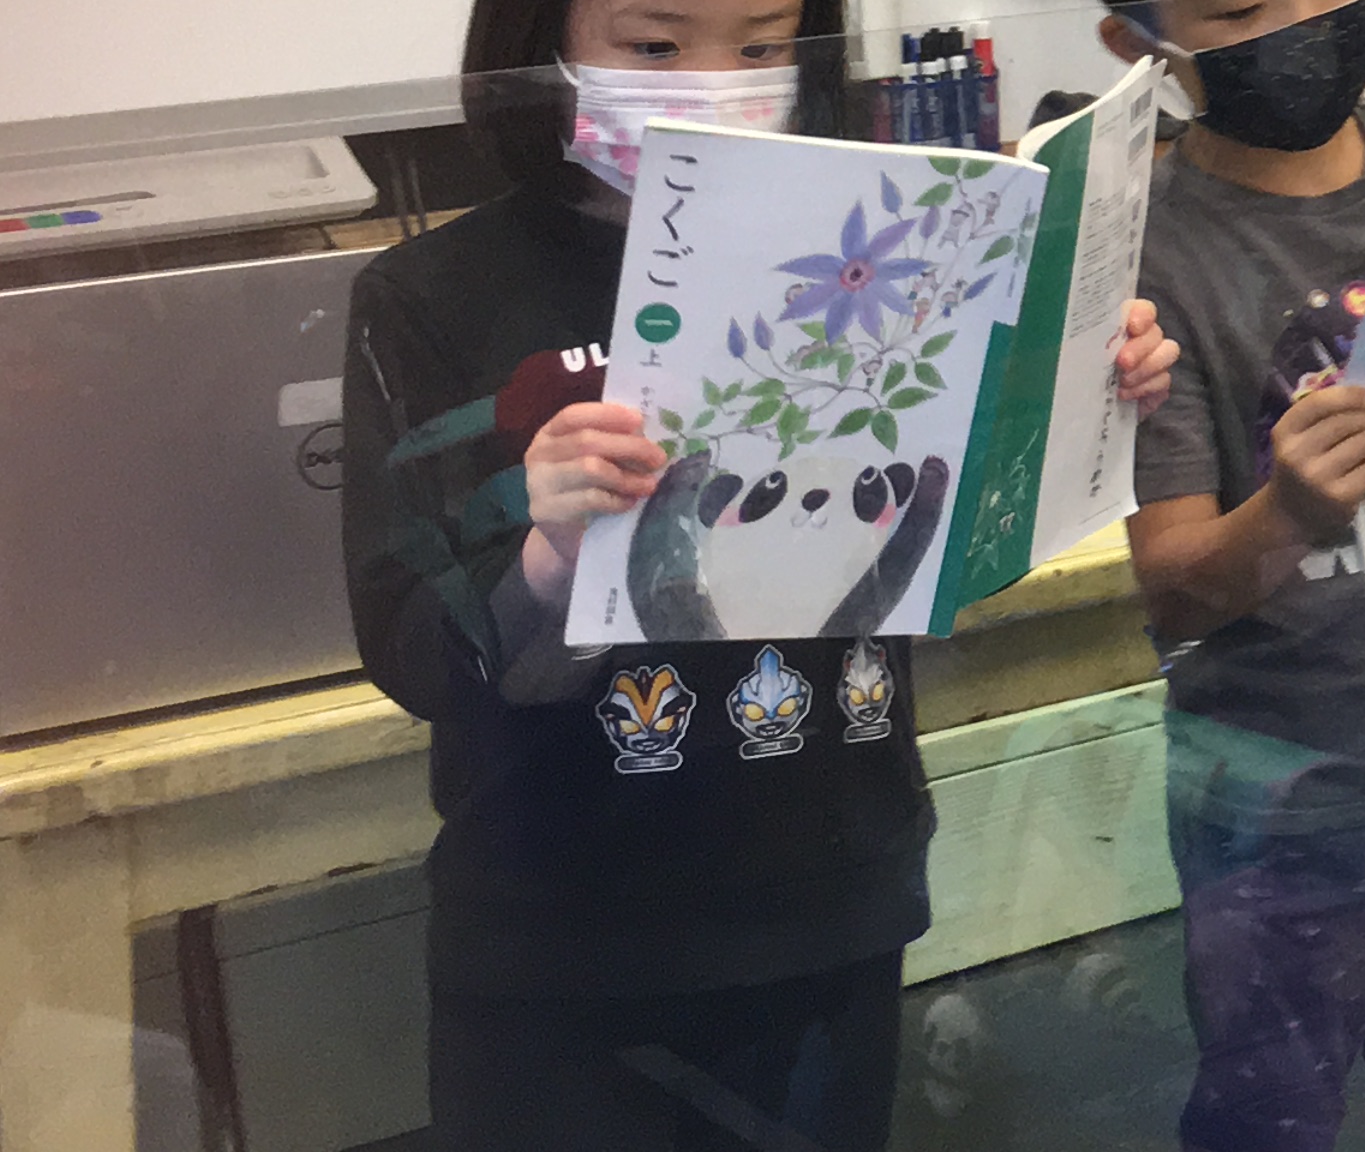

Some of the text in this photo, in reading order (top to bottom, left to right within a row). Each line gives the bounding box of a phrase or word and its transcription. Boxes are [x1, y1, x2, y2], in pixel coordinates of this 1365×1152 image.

[647, 153, 698, 288] こくご
[640, 348, 662, 367] 上
